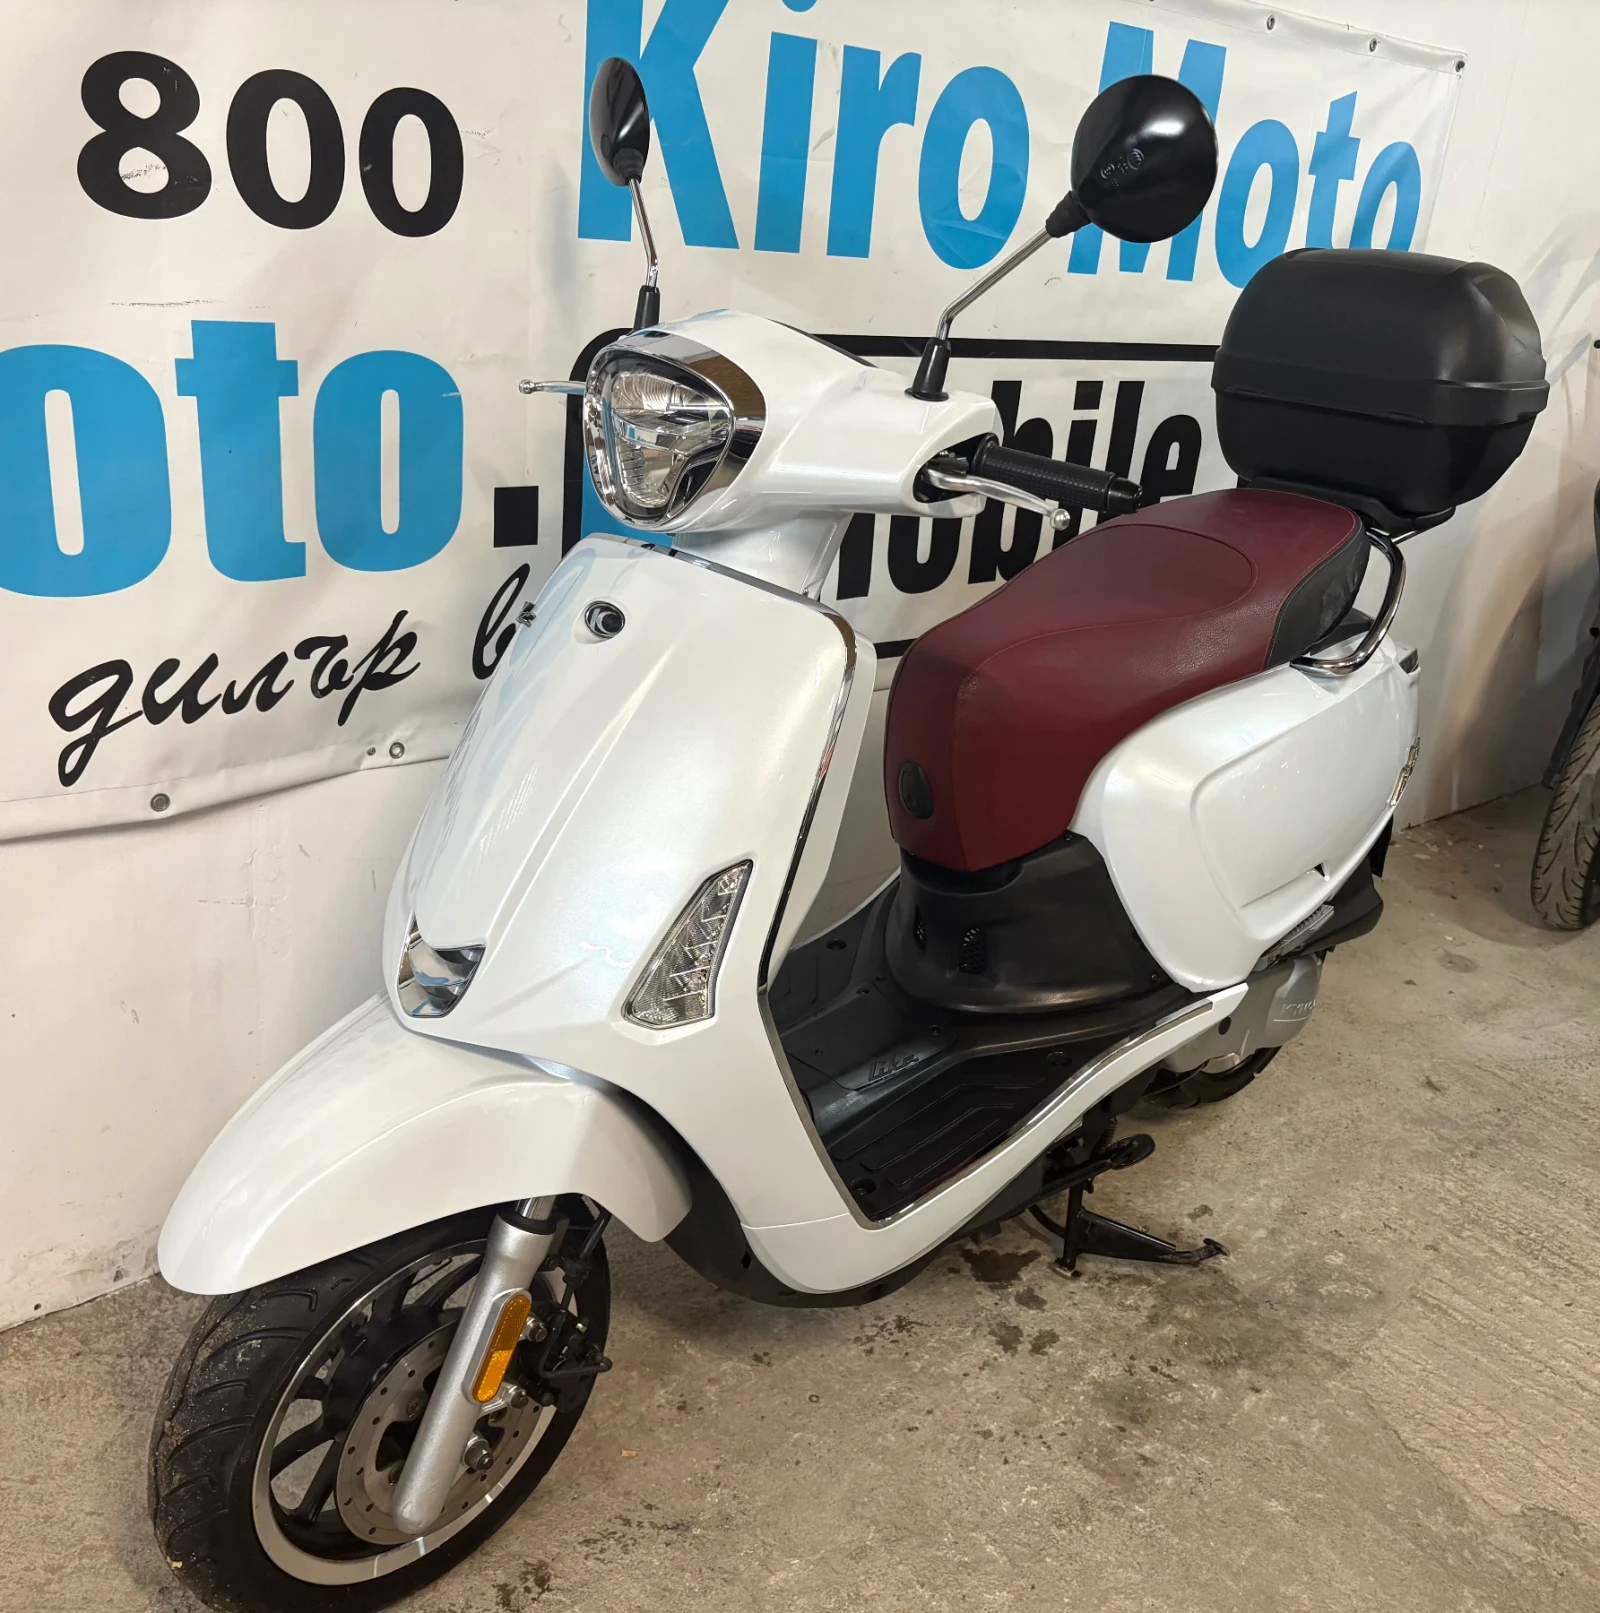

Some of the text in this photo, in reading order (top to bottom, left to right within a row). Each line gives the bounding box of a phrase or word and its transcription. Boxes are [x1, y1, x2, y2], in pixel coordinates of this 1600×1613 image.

[78, 51, 464, 237] 800
[578, 0, 1030, 270] Kiro
[48, 610, 421, 787] дилър
